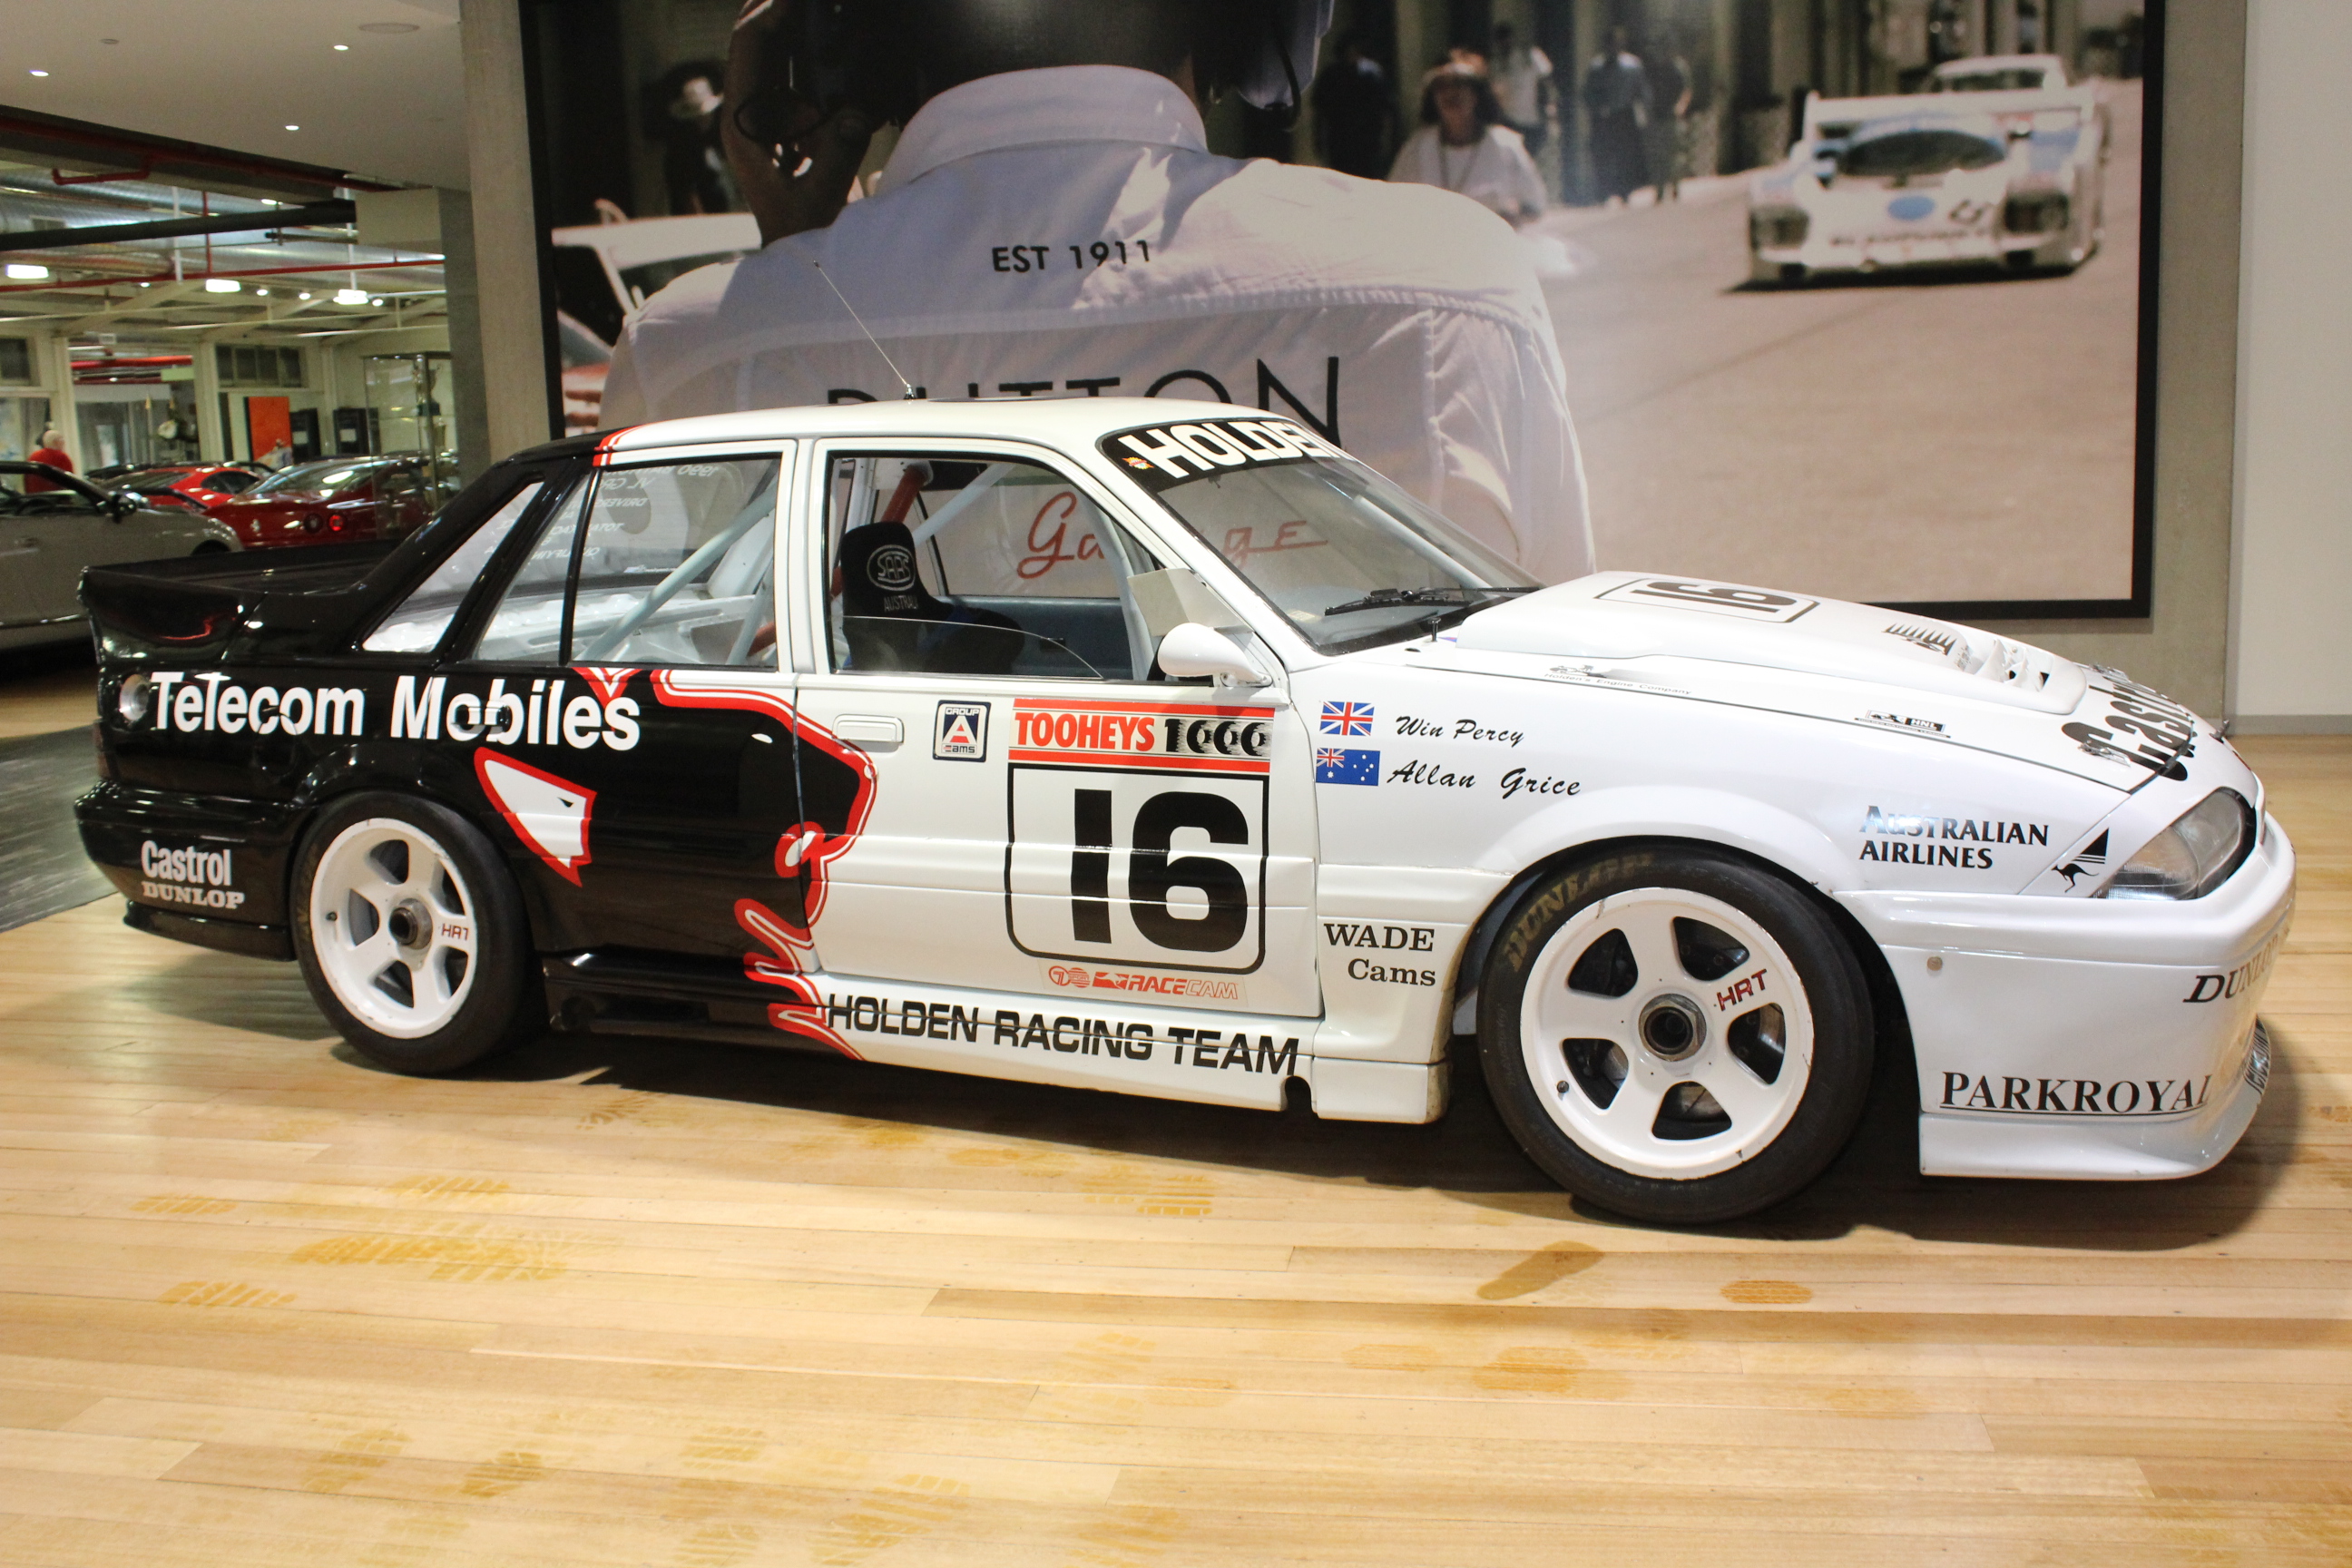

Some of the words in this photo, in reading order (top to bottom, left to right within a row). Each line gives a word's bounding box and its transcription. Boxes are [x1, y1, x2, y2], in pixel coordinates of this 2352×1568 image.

[992, 246, 1049, 272] EST
[1069, 240, 1150, 270] 1911
[1117, 421, 1340, 479] HOLDEN
[1639, 684, 1692, 695] Company
[150, 671, 365, 735] Telecom
[390, 675, 641, 750] Mobiles
[946, 708, 980, 716] GROUP
[1014, 712, 1155, 752] TOOHEYS
[1165, 719, 1270, 757] 1000
[1395, 716, 1444, 738] Win
[1453, 719, 1524, 748] Percy
[1387, 760, 1476, 789] Allan
[1500, 768, 1581, 799] Grice
[1859, 805, 2049, 847] AUSTRALIAN
[142, 840, 232, 886] Castrol
[1071, 789, 1249, 953] 16
[1859, 840, 1994, 869] AIRLINES
[142, 881, 245, 909] DUNLOP
[1324, 923, 1435, 952] WADE
[1128, 975, 1239, 1000] RACECAM
[1348, 958, 1436, 986] Cams
[1716, 968, 1767, 1012] HRT
[828, 993, 980, 1043] HOLDEN
[994, 1010, 1153, 1061] RACING
[1168, 1027, 1299, 1075] TEAM
[1942, 1071, 2212, 1114] PARKROYAL
